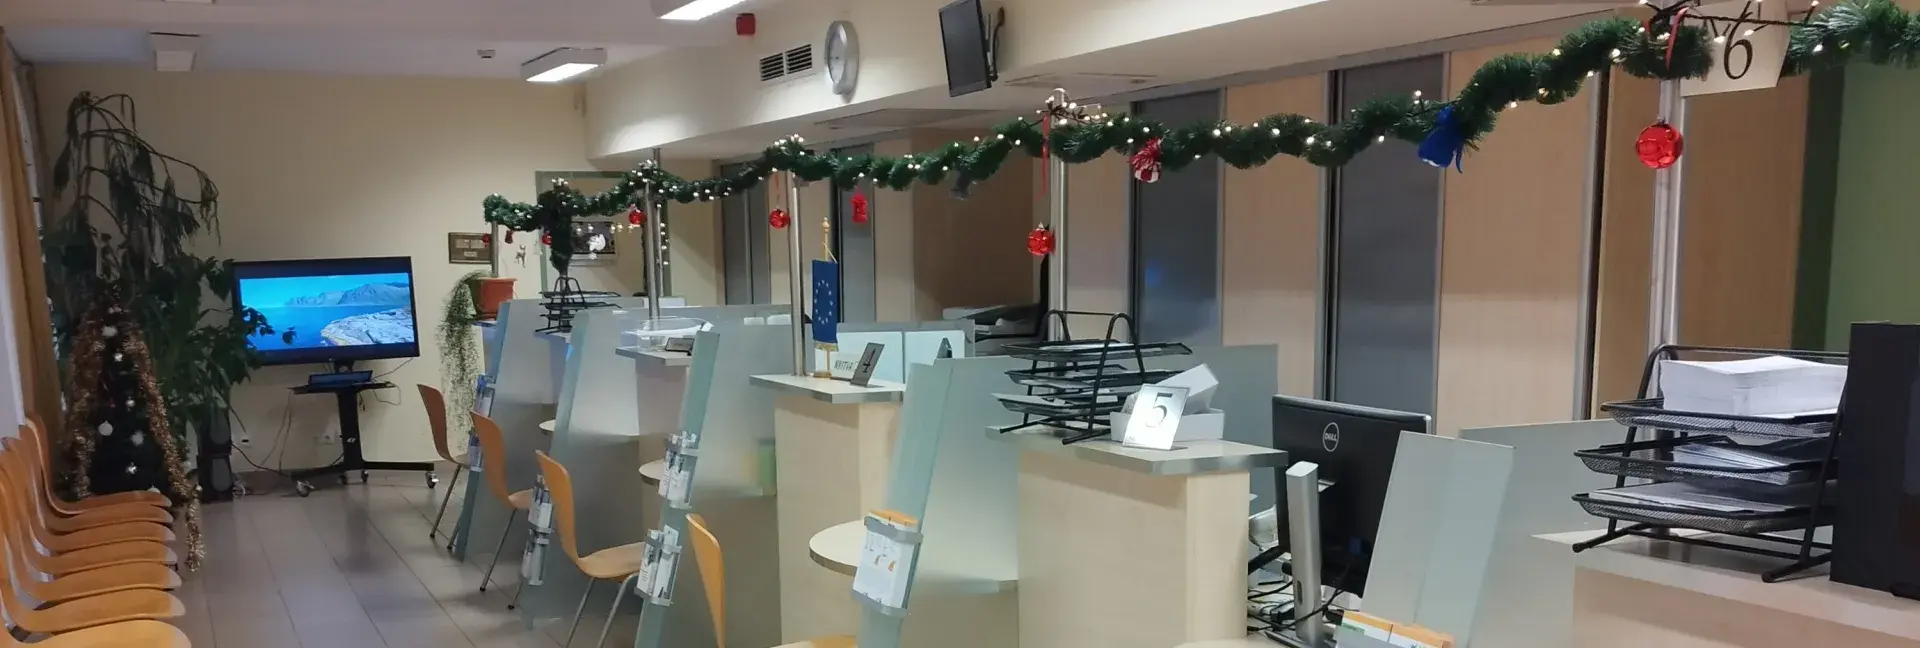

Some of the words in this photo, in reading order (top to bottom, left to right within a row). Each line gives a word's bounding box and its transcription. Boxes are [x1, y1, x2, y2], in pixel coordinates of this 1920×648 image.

[1723, 9, 1754, 80] 6
[862, 347, 877, 374] 4
[1144, 391, 1174, 429] 5
